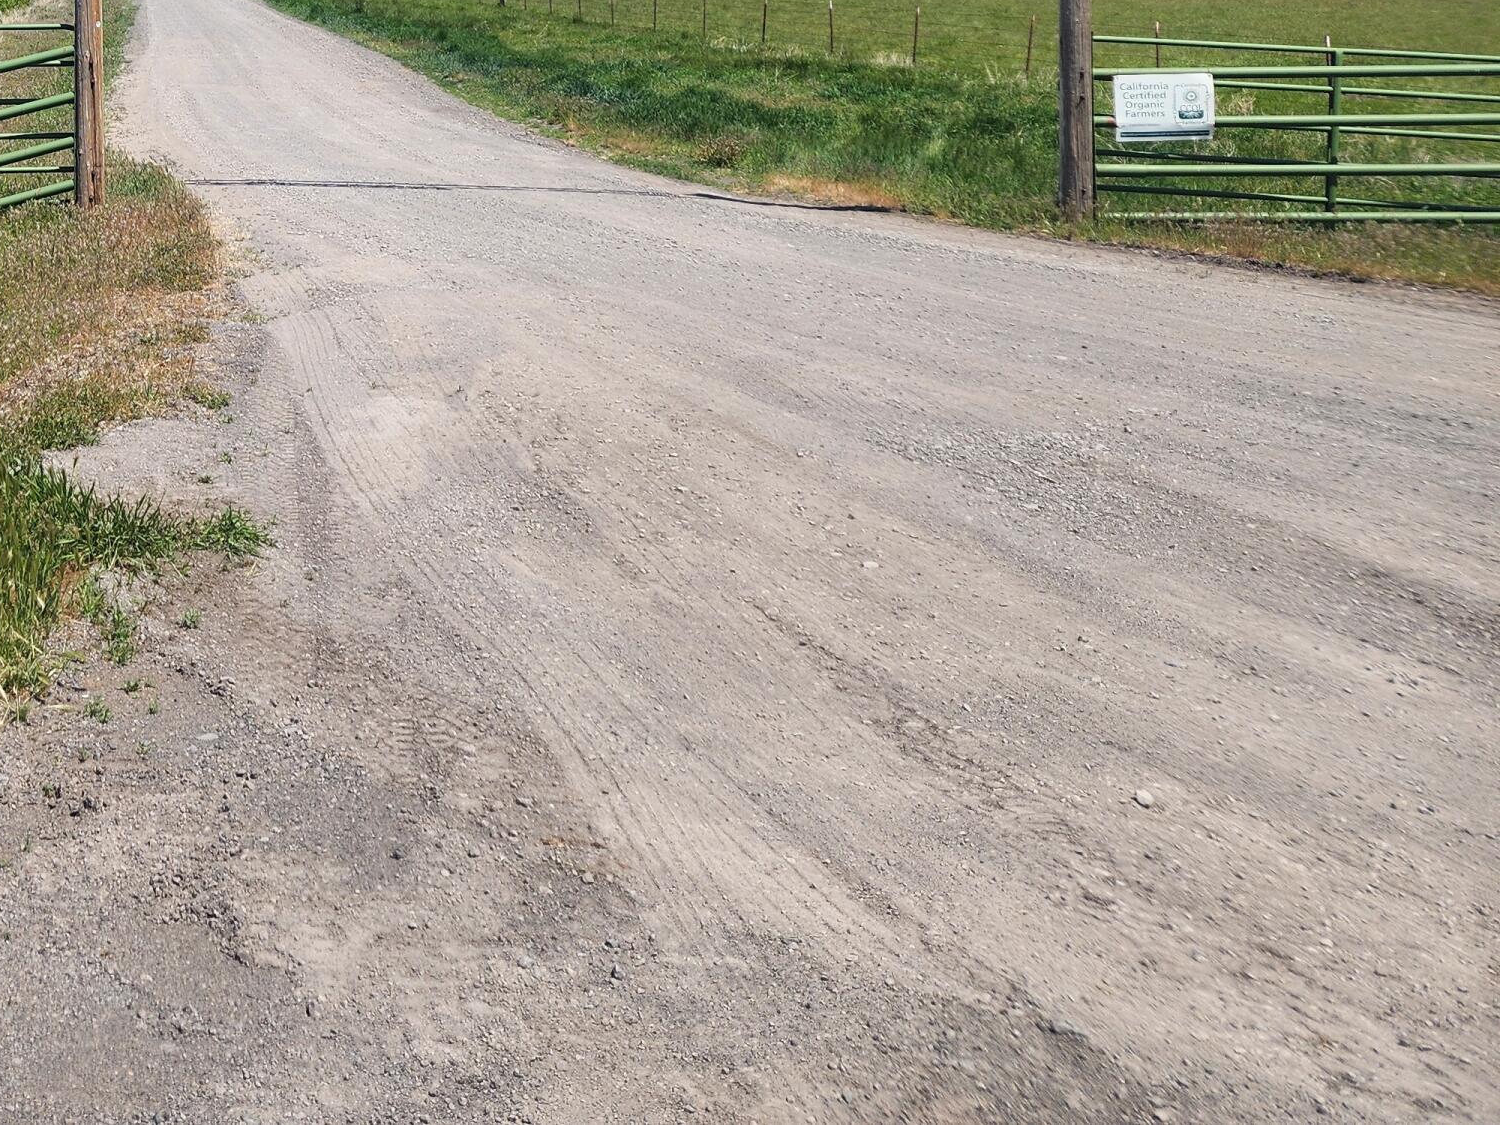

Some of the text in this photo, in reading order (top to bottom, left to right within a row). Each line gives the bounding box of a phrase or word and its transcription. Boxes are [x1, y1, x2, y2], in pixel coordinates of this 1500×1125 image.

[1119, 82, 1169, 91] California
[1122, 91, 1167, 100] Certified
[1125, 100, 1165, 110] Organic
[1125, 110, 1165, 118] Farmers
